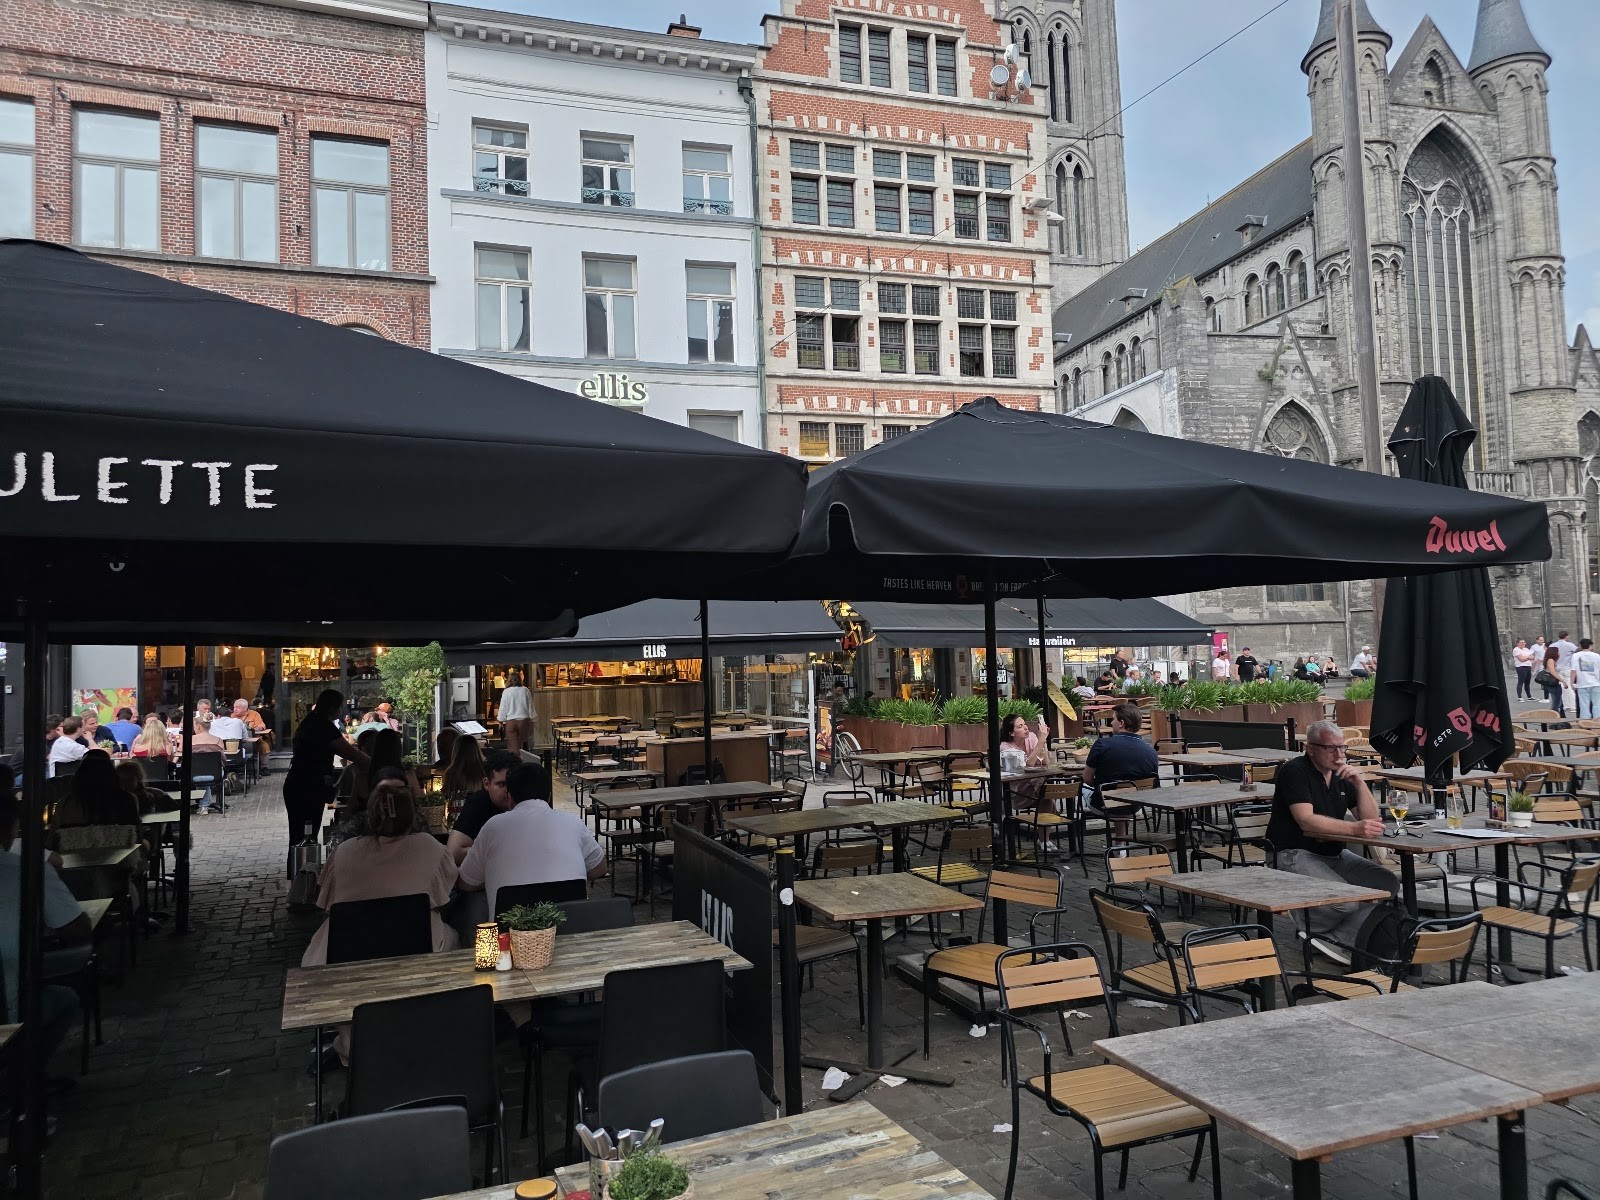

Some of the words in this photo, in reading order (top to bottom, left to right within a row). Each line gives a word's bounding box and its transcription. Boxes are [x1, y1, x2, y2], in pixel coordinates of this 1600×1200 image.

[580, 373, 647, 401] ellis
[1425, 515, 1507, 554] Duvel
[883, 577, 909, 589] TASTES
[910, 579, 925, 590] LIKE
[926, 580, 953, 591] HEAVEN
[642, 644, 667, 659] ELLIS
